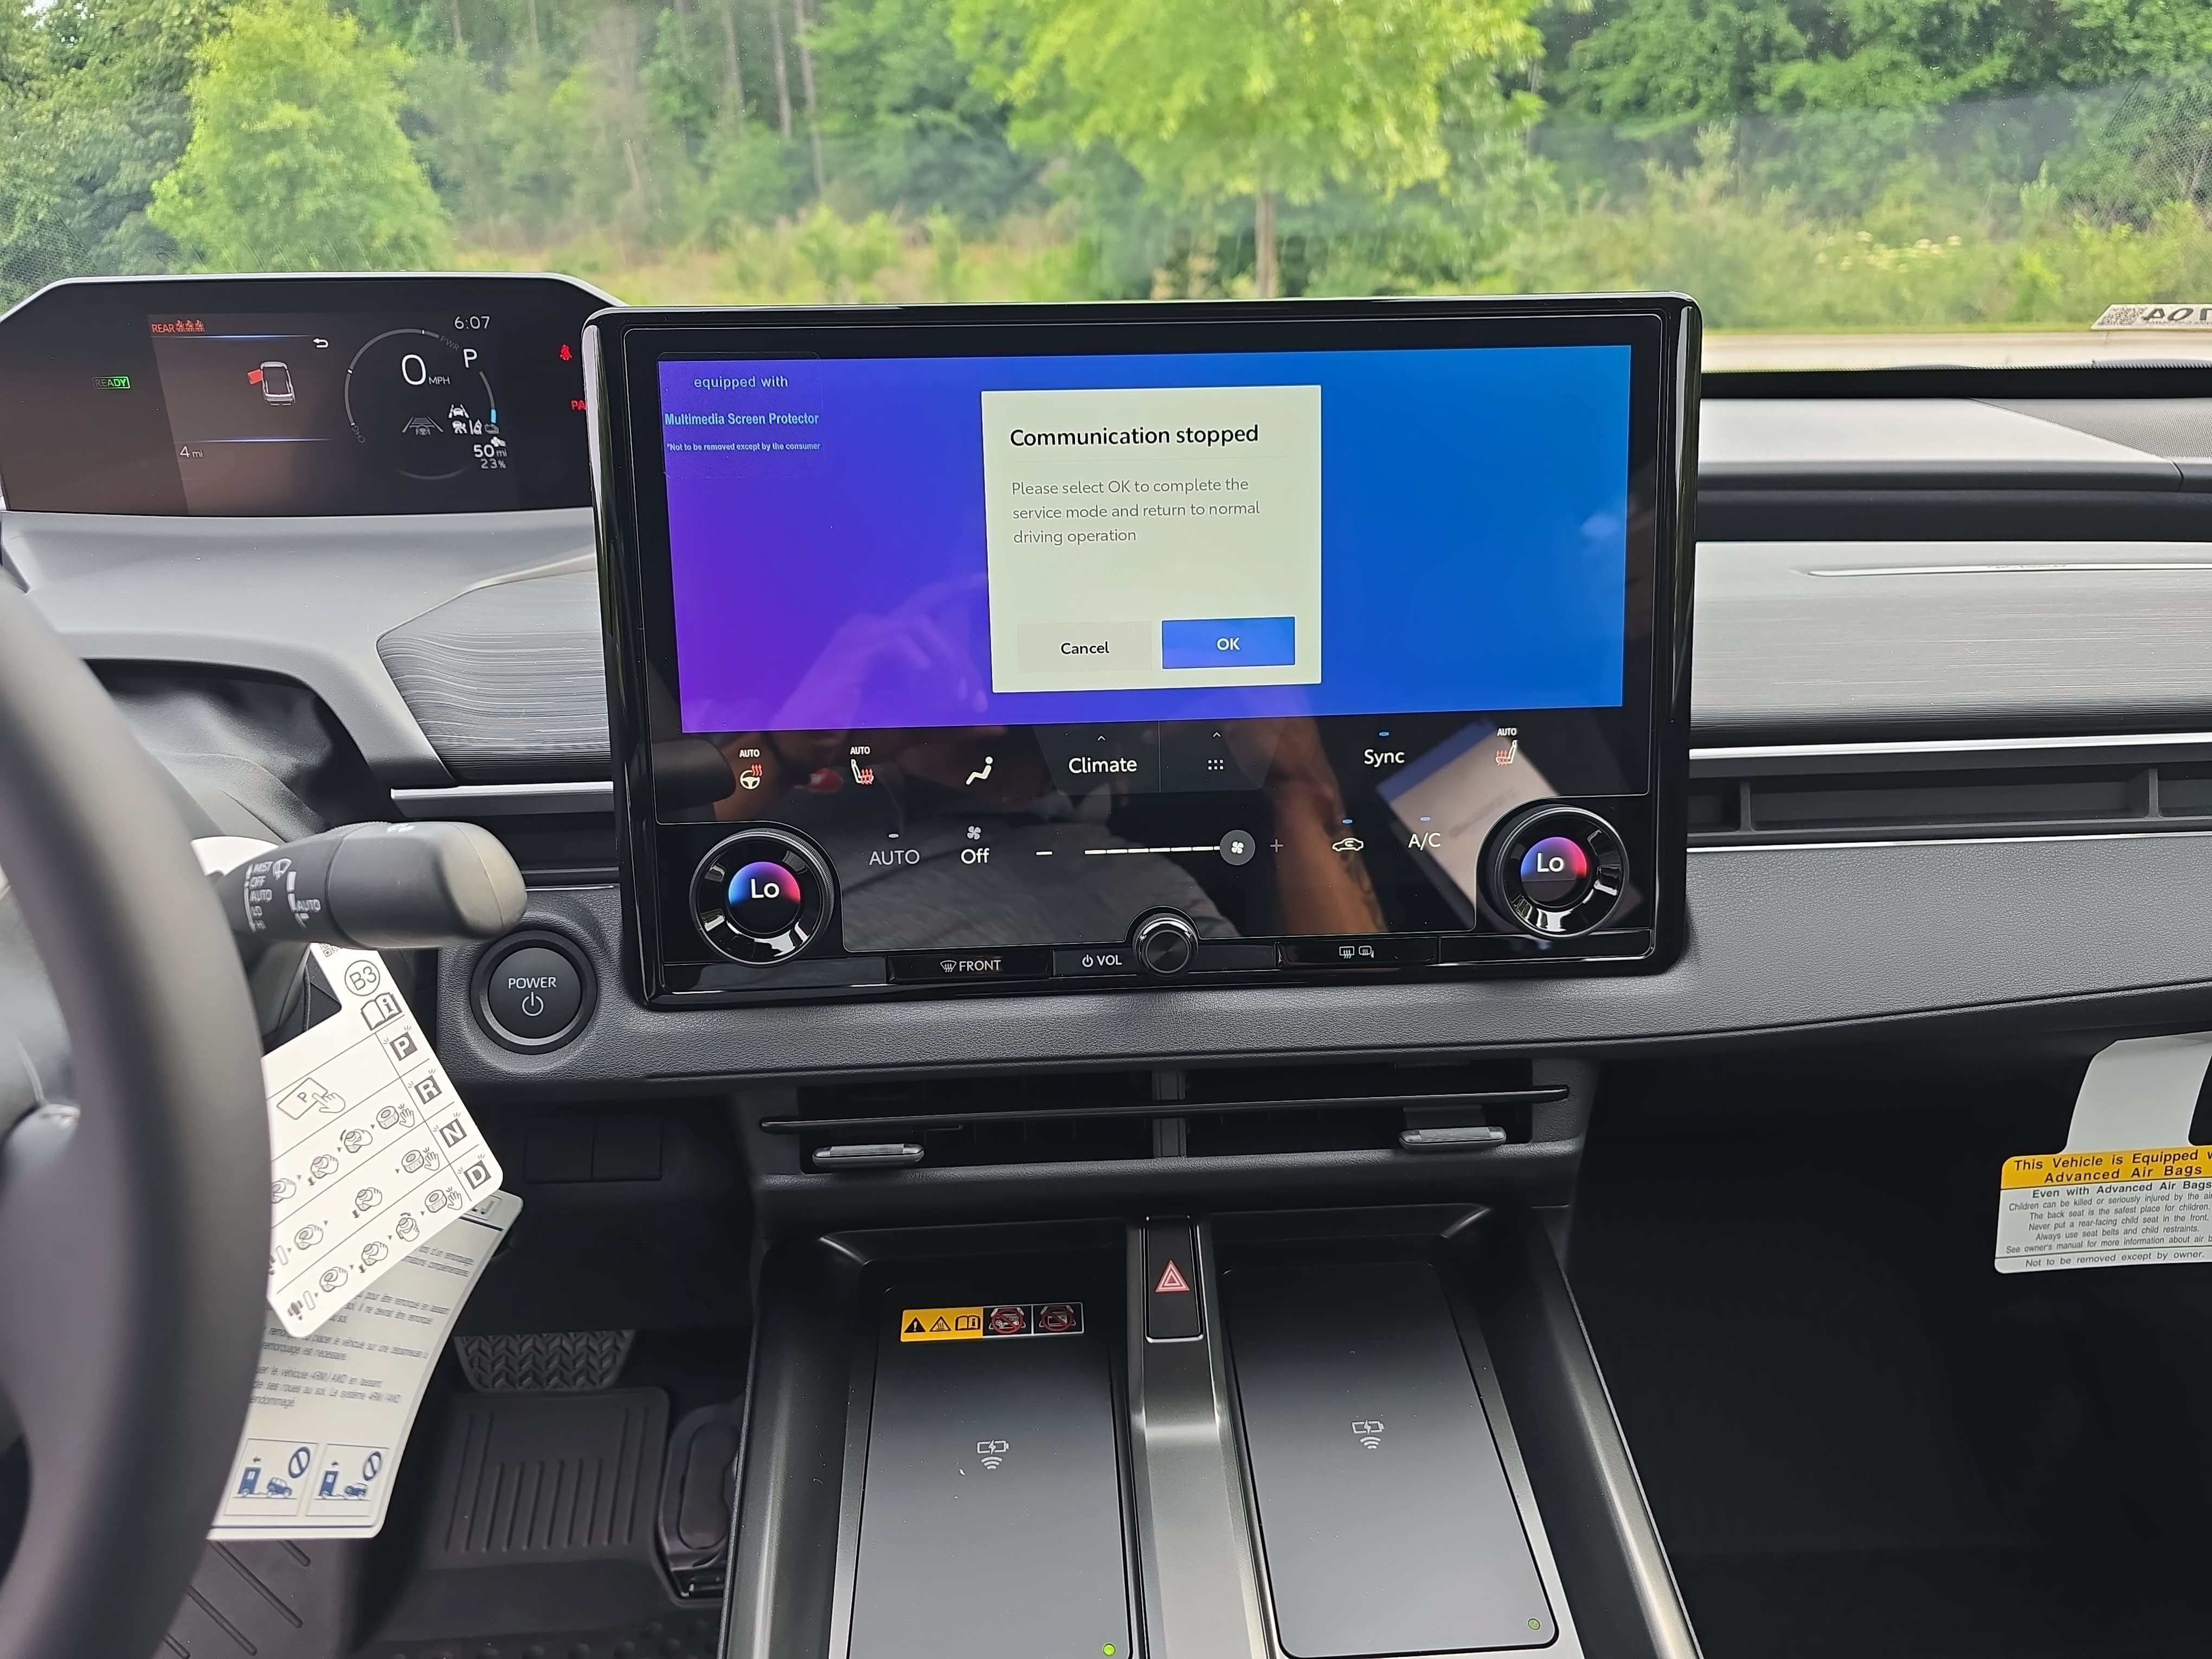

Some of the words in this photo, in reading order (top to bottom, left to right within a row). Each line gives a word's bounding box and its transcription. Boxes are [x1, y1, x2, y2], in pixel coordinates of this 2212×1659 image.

[151, 324, 176, 332] REAR
[454, 316, 490, 329] 6:07
[440, 335, 460, 351] PWR
[464, 348, 478, 368] P
[401, 354, 427, 385] 0
[428, 376, 451, 385] MPH
[95, 378, 126, 387] READY
[693, 376, 756, 390] equipped
[761, 376, 788, 388] with
[664, 413, 725, 425] Multimedia
[728, 413, 766, 425] Screen
[769, 412, 819, 425] Protector
[352, 425, 365, 443] CHG
[1009, 426, 1170, 446] Communication
[1176, 424, 1259, 447] stopped
[179, 446, 190, 458] 4
[192, 449, 203, 458] mi
[473, 444, 494, 458] 50
[736, 443, 760, 451] except
[762, 442, 771, 451] by
[1012, 481, 1059, 495] Please
[1062, 481, 1104, 494] select
[1108, 480, 1131, 493] OK
[1134, 481, 1149, 493] to
[1153, 478, 1221, 495] complete
[1225, 477, 1249, 491] the
[1012, 506, 1062, 519] service
[1066, 505, 1108, 518] mode
[1111, 504, 1139, 517] and
[1142, 504, 1186, 517] return
[1190, 504, 1205, 516] to
[1209, 501, 1260, 515] normal
[1013, 530, 1063, 545] driving
[1067, 529, 1136, 545] operation
[1060, 641, 1110, 655] Cancel
[1216, 637, 1240, 651] OK
[1497, 727, 1517, 736] AUTO
[739, 749, 760, 757] AUTO
[850, 746, 871, 755] AUTO
[1364, 749, 1405, 768] Sync
[1068, 757, 1138, 773] Climate
[1408, 833, 1441, 849] A/C
[869, 849, 920, 866] AUTO
[960, 848, 990, 865] Off
[1536, 853, 1564, 873] Lo
[254, 861, 273, 873] MIST
[249, 876, 266, 888] OFF
[750, 878, 780, 899] Lo
[250, 889, 272, 902] AUTO
[296, 899, 321, 912] AUTO
[959, 960, 1001, 972] FRONT
[1096, 955, 1123, 966] VOL
[349, 966, 377, 991] B3
[508, 976, 557, 989] POWER
[394, 1036, 410, 1058] P
[420, 1078, 439, 1101] R
[444, 1123, 464, 1144] N
[2014, 1159, 2043, 1171] This
[2053, 1156, 2103, 1168] Vehicle
[2112, 1154, 2123, 1165] is
[2132, 1149, 2198, 1165] Equipped
[469, 1164, 488, 1187] D
[2044, 1168, 2120, 1184] Advanced
[2131, 1167, 2153, 1178] Air
[2164, 1165, 2202, 1177] Bags
[2033, 1189, 2060, 1198] Even
[2066, 1186, 2089, 1195] with
[2096, 1182, 2153, 1194] Advanced
[2159, 1181, 2176, 1191] Air
[2183, 1180, 2212, 1191] Bags
[2009, 1202, 2039, 1211] Children
[2060, 1199, 2069, 1207] be
[2074, 1198, 2093, 1206] killed
[2108, 1194, 2141, 1204] seriously
[2145, 1193, 2170, 1203] injured
[2174, 1192, 2183, 1202] by
[2188, 1192, 2200, 1200] the
[2030, 1212, 2043, 1220] The
[2047, 1211, 2065, 1219] back
[2068, 1209, 2084, 1217] seat
[2088, 1208, 2094, 1216] is
[2098, 1207, 2110, 1216] the
[2114, 1206, 2137, 1214] safest
[2140, 1205, 2160, 1214] place
[2165, 1204, 2175, 1212] for
[2178, 1202, 2210, 1211] children.
[2028, 1222, 2050, 1231] Never
[2054, 1221, 2066, 1231] put
[2078, 1218, 2117, 1227] rear-facing
[2121, 1216, 2139, 1224] child
[2143, 1215, 2159, 1224] seat
[2163, 1214, 2170, 1222] in
[2174, 1214, 2186, 1222] the
[2190, 1213, 2209, 1221] front.
[2035, 1232, 2061, 1242] Always
[2082, 1229, 2098, 1238] seat
[2101, 1227, 2119, 1236] belts
[2123, 1226, 2138, 1236] and
[2142, 1225, 2159, 1234] child
[2163, 1224, 2200, 1233] restraints.
[2005, 1245, 2021, 1254] See
[2024, 1243, 2053, 1252] owner's
[2056, 1240, 2084, 1250] manual
[2100, 1239, 2120, 1247] more
[2124, 1236, 2165, 1245] information
[2169, 1235, 2190, 1244] about
[2194, 1234, 2204, 1243] air
[2025, 1259, 2042, 1268] Not
[2060, 1257, 2071, 1265] be
[2076, 1254, 2116, 1264] removed
[2121, 1252, 2152, 1262] except
[2157, 1251, 2169, 1261] by
